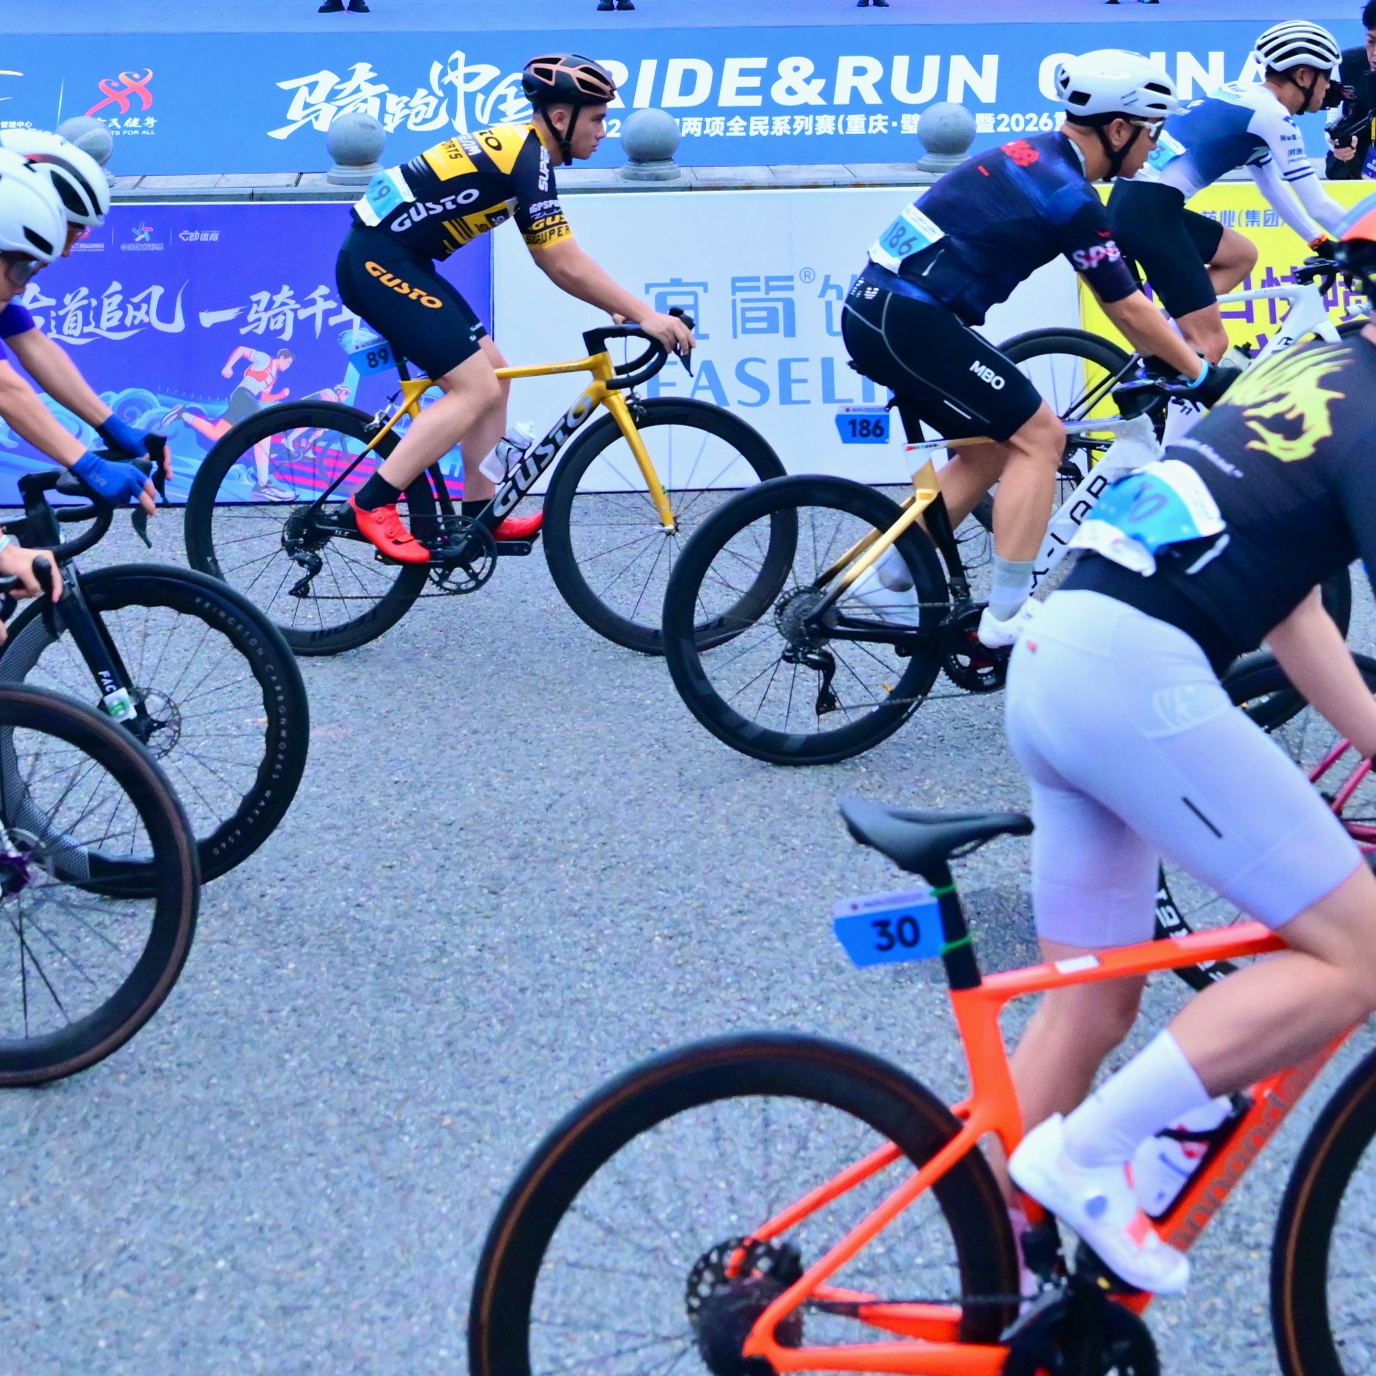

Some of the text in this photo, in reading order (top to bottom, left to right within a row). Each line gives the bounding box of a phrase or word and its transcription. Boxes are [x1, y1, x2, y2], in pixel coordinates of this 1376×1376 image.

[390, 188, 481, 233] GUSTO
[529, 213, 568, 231] GUS
[364, 260, 444, 309] GUSTO
[366, 347, 390, 369] 89
[969, 360, 1007, 391] MBO
[847, 418, 886, 439] 186
[492, 394, 593, 518] GUSTO
[870, 914, 922, 953] 30
